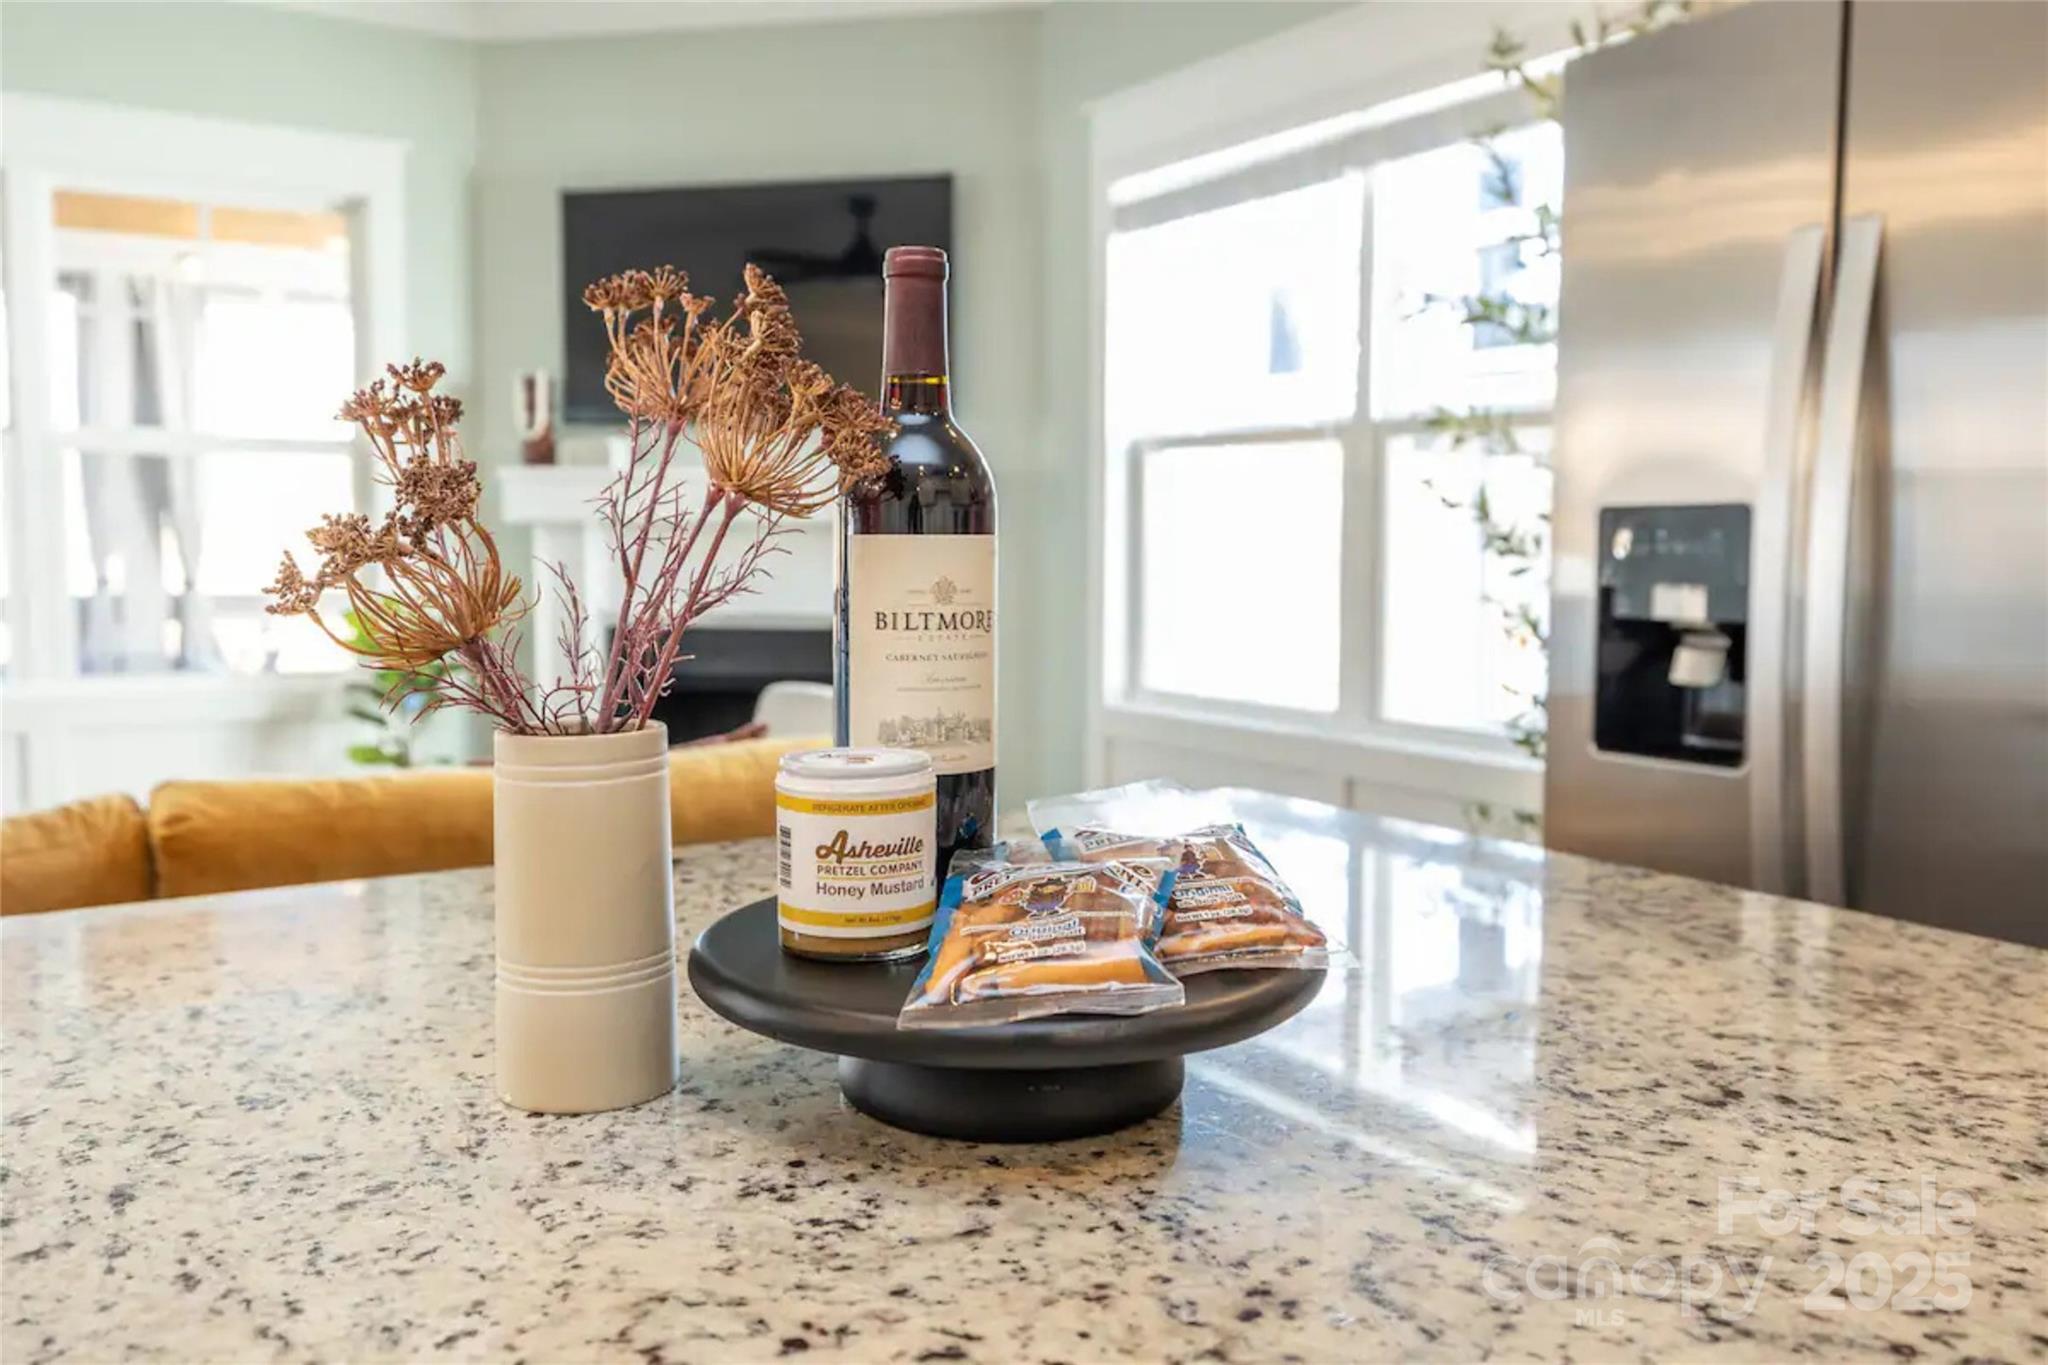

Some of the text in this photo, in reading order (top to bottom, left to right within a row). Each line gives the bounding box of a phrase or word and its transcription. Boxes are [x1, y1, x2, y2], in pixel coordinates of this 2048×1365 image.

[815, 829, 925, 865] Asheville
[817, 860, 923, 876] PRETZEL COMPANY
[816, 876, 925, 900] Honey Mustard
